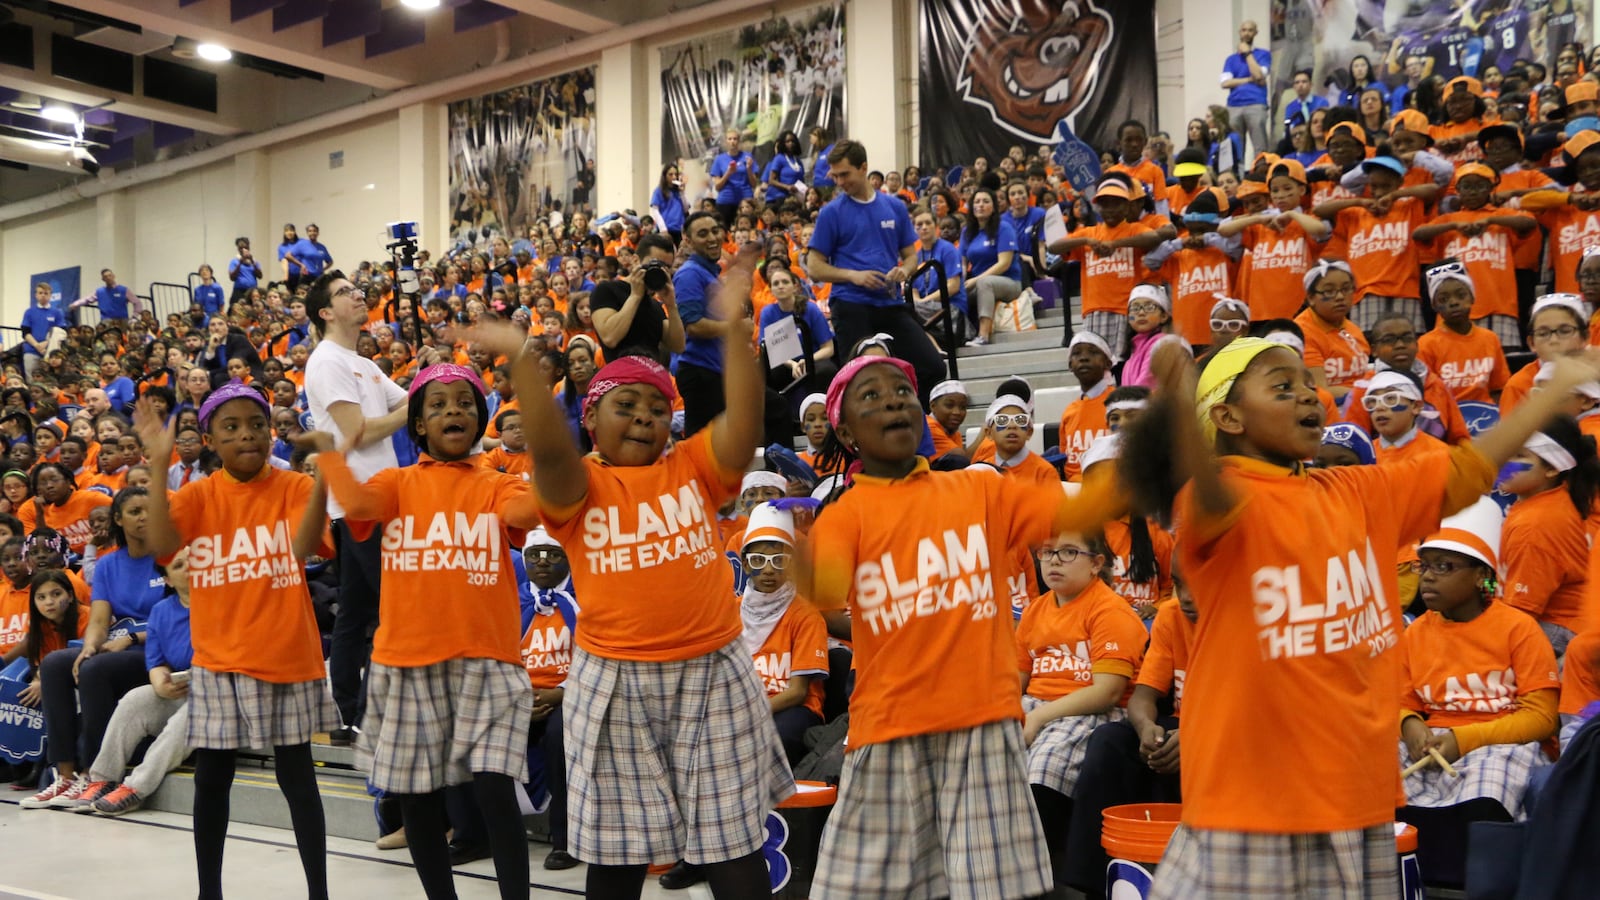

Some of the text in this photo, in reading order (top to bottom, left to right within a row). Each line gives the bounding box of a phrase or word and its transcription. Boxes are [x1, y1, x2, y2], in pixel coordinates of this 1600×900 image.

[1502, 27, 1516, 50] 8
[381, 512, 500, 572] SLAM!
[586, 526, 707, 575] THE EXAM
[189, 556, 289, 588] THE EXAM
[382, 549, 487, 572] THE EXAM
[272, 574, 301, 589] 2016
[467, 572, 498, 586] 2016
[916, 571, 994, 617] EXAM
[1258, 602, 1381, 661] THE EXAM
[1104, 641, 1119, 651] SA
[526, 652, 570, 669] EXAM
